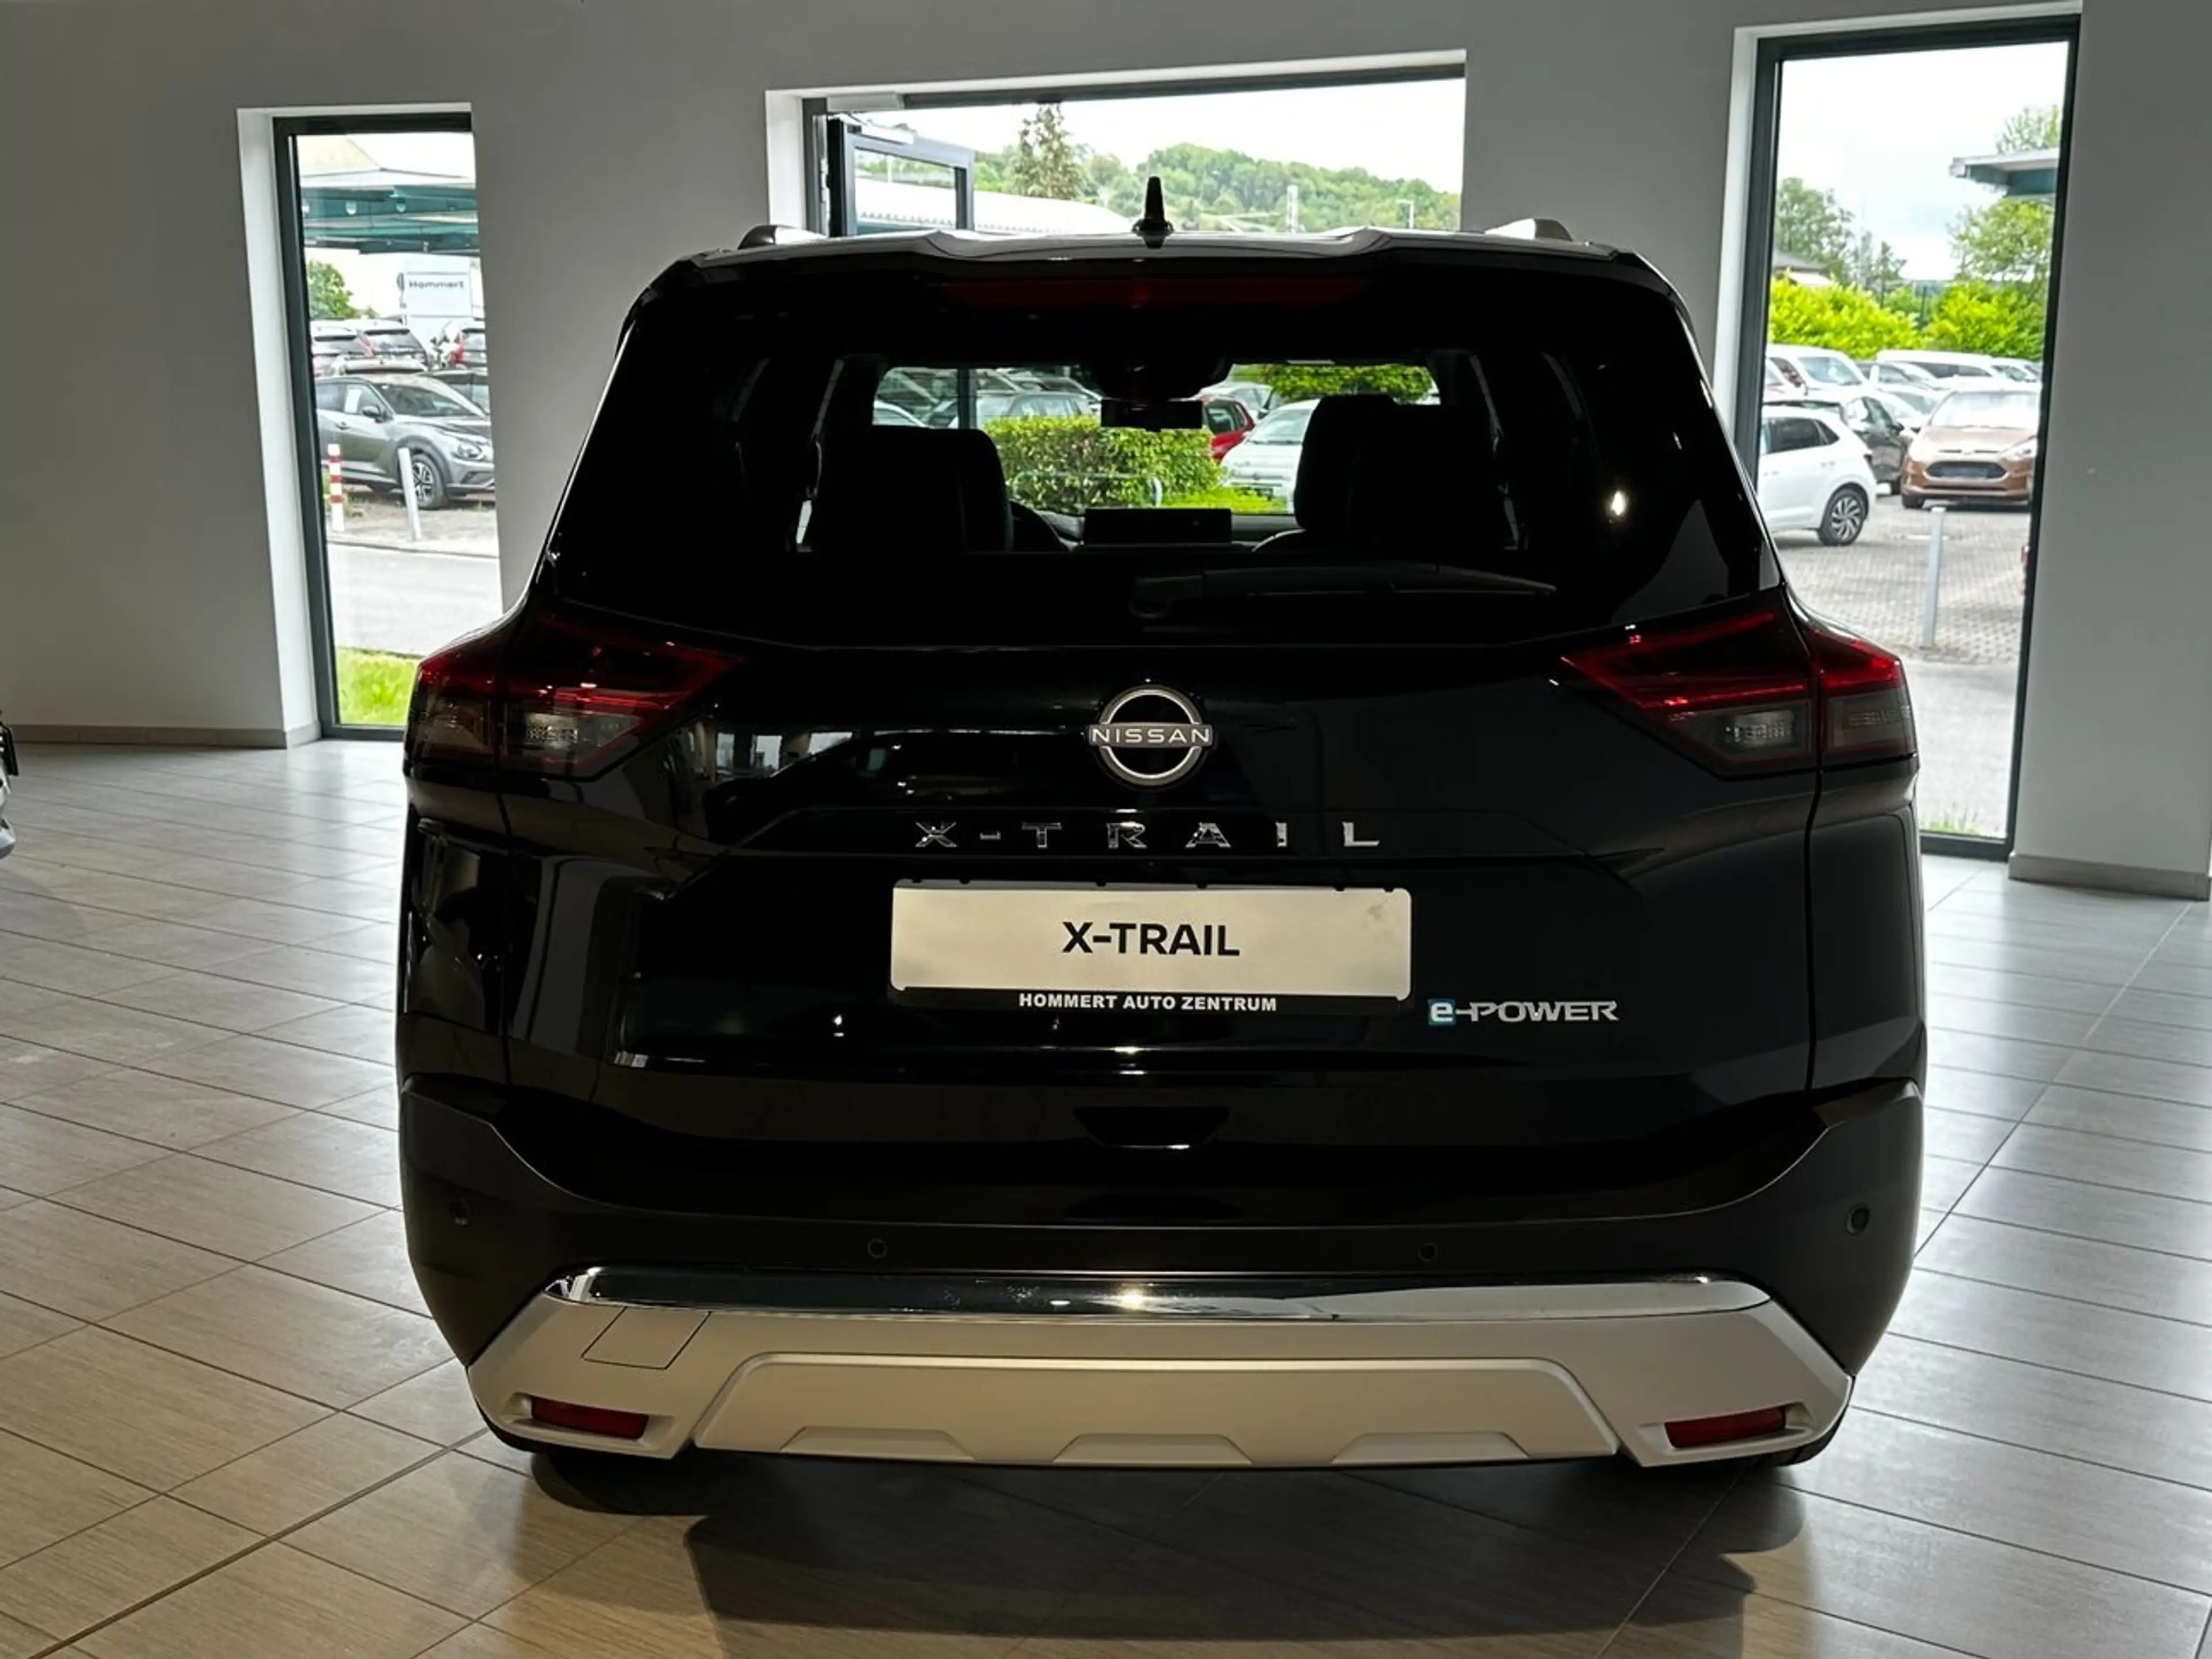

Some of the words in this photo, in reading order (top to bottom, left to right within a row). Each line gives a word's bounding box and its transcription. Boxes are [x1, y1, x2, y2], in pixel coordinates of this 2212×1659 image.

[1092, 728, 1209, 743] NISSAN
[915, 821, 1380, 848] X-TRAIL
[1062, 921, 1240, 956] X-TRAIL
[1019, 993, 1117, 1009] HOMMERT
[1123, 995, 1176, 1010] AUTO
[1181, 996, 1277, 1012] ZENTRUM
[1430, 1001, 1620, 1022] e-POWER
